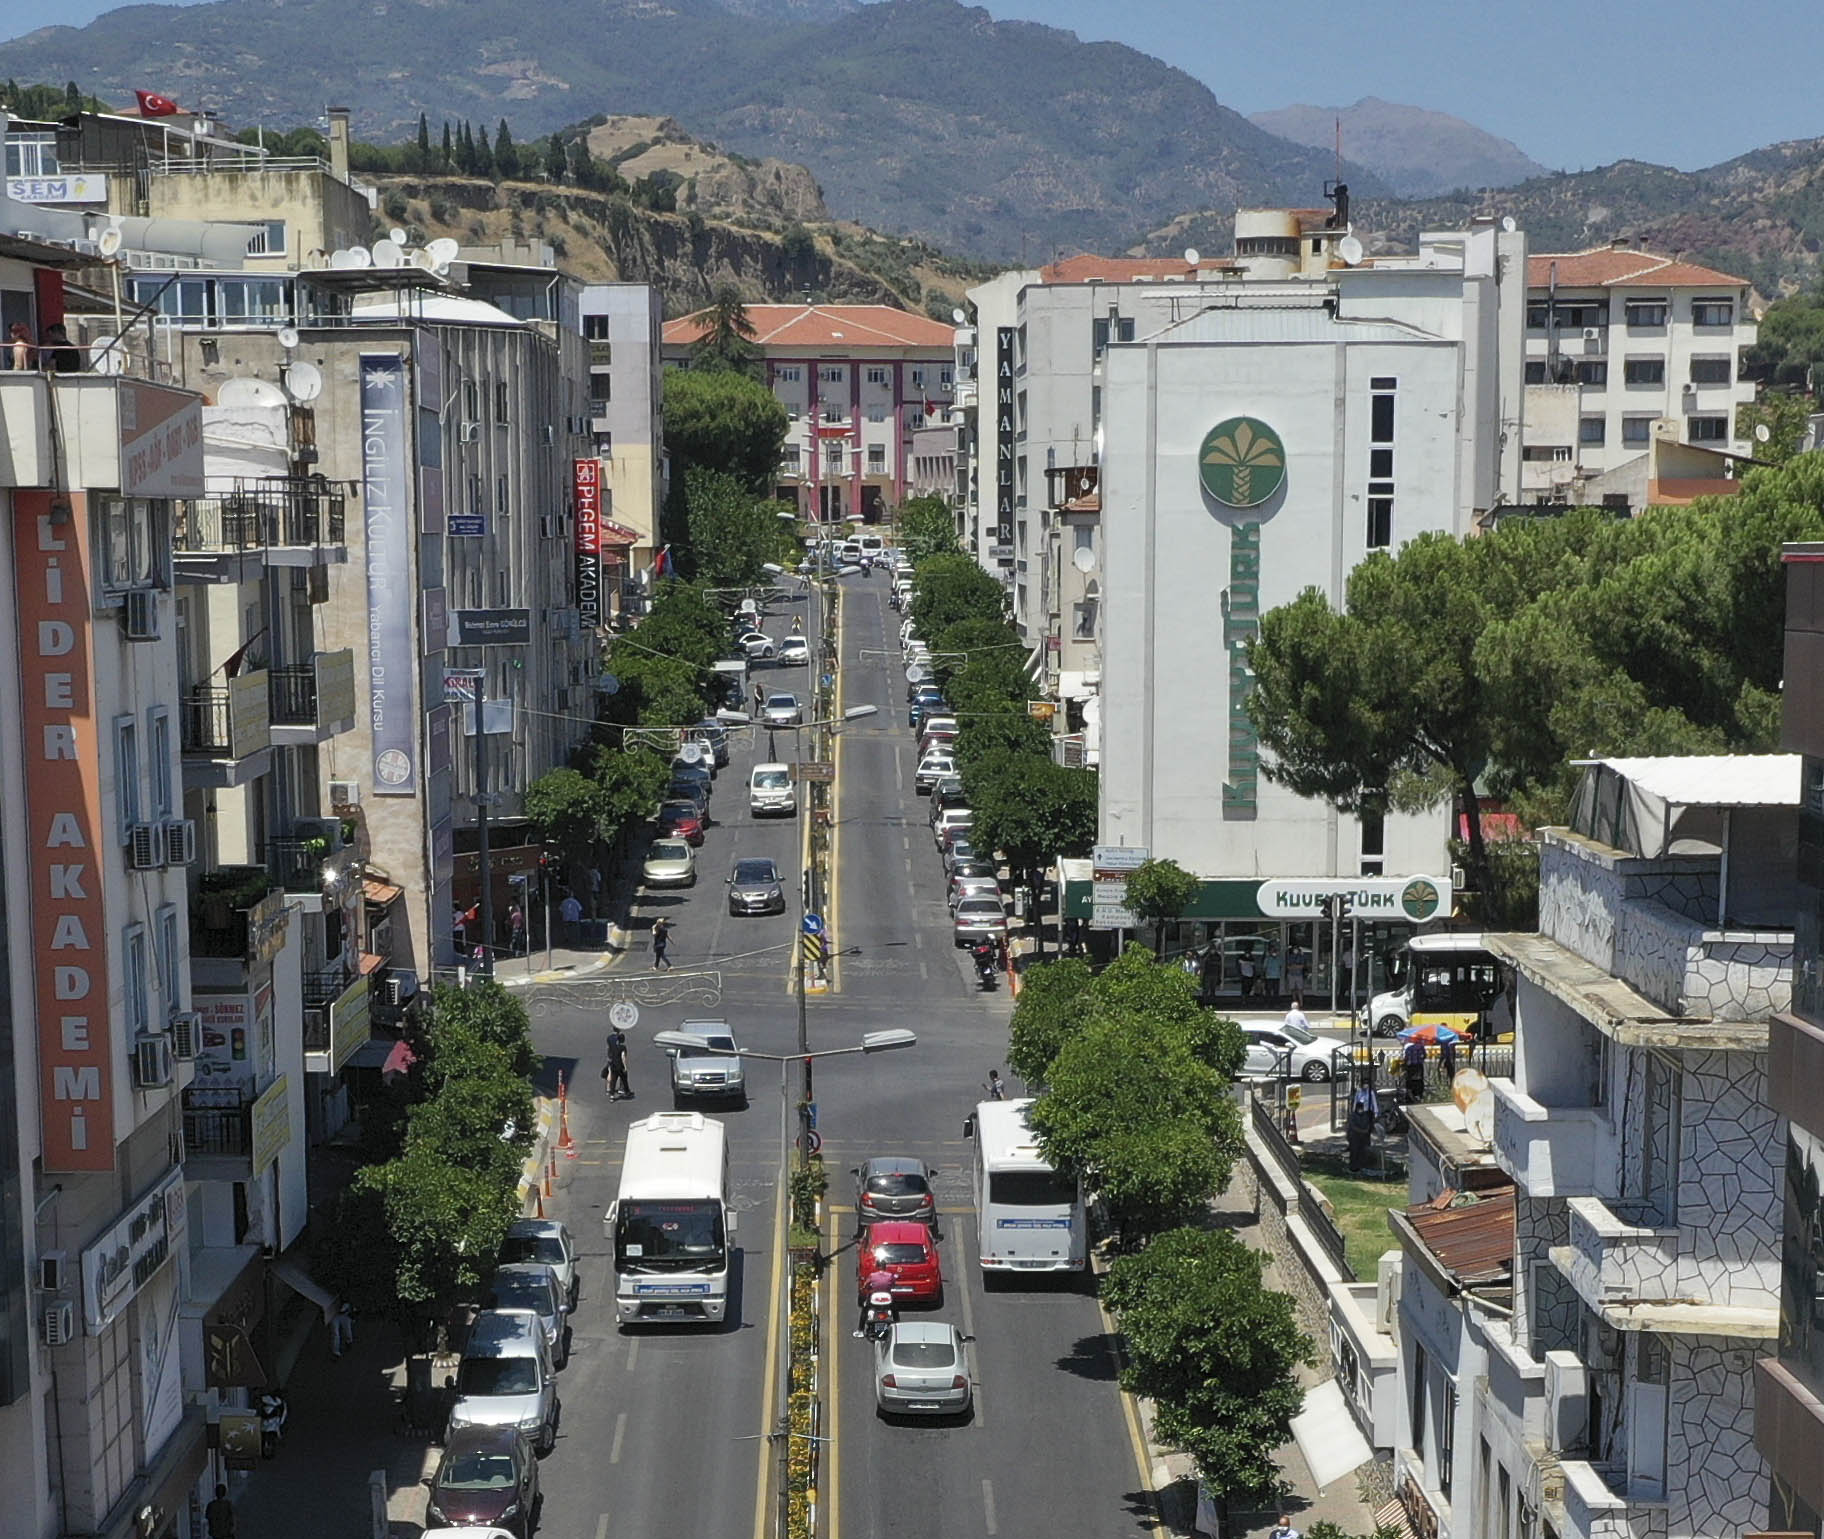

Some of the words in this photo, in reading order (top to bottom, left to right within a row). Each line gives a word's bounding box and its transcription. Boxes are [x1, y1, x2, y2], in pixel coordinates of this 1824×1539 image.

[13, 182, 67, 198] SEM
[999, 332, 1012, 539] YAMANLAR
[579, 554, 597, 629] AKADEM
[38, 514, 79, 760] LİDER
[372, 666, 384, 685] Dil
[372, 690, 385, 731] Kursu
[46, 811, 100, 1151] AKADEMİ
